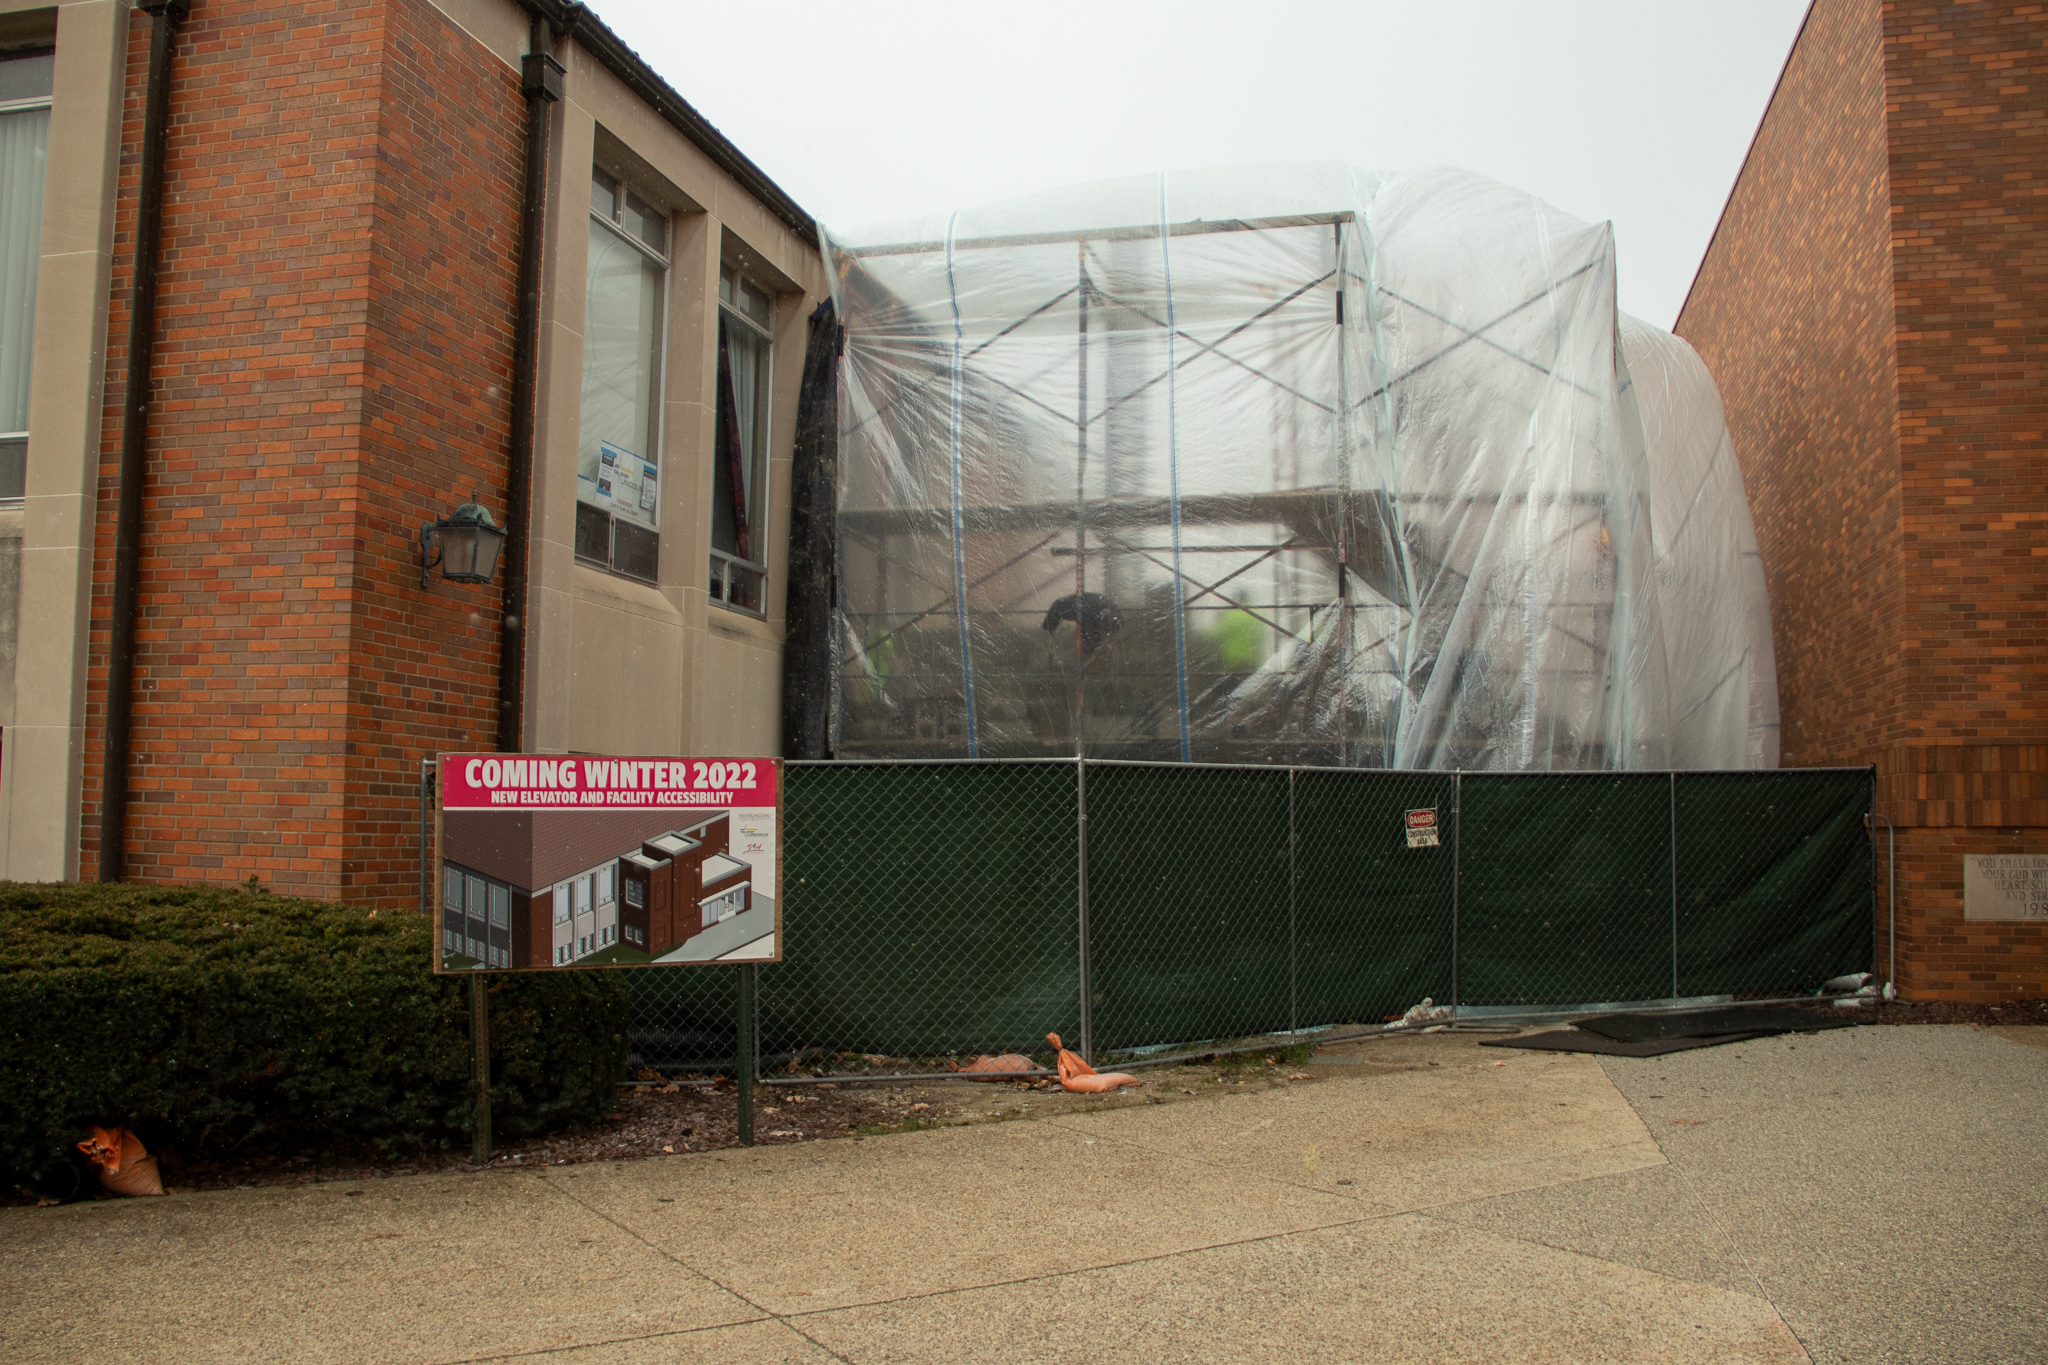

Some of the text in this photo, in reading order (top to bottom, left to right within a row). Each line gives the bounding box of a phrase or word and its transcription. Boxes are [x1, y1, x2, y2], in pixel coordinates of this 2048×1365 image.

[465, 759, 757, 789] COMING WINTER 2022
[491, 790, 734, 804] NEW ELEVATOR AND FACILITY ACCESSIBILITY
[1409, 814, 1434, 824] DANGER
[1999, 857, 2029, 869] SHALL
[1981, 869, 2006, 879] YOUR
[2009, 869, 2029, 879] GOD
[2005, 890, 2026, 901] AND
